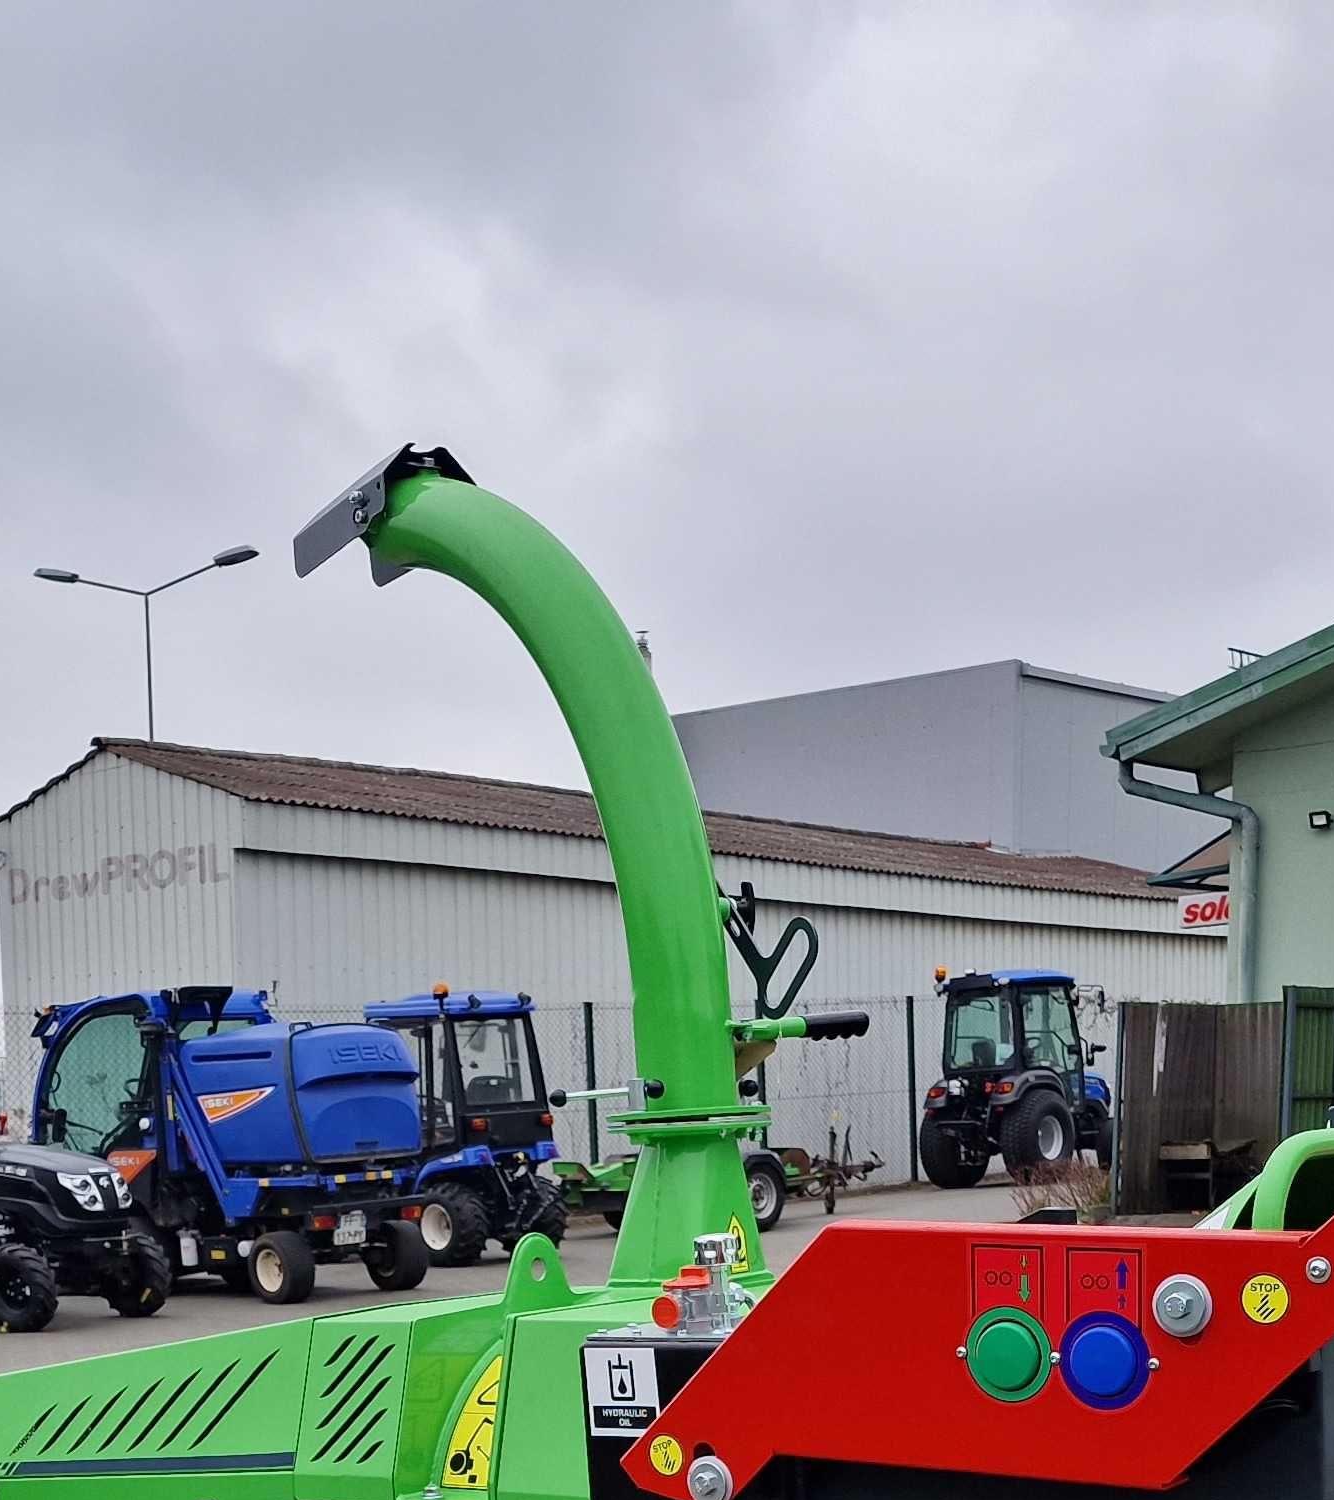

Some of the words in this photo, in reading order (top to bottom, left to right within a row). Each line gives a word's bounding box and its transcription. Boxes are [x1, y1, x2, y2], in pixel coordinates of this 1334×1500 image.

[10, 843, 230, 905] DrewPROFIL
[327, 1044, 403, 1065] ISEKI
[1250, 1282, 1280, 1293] STOP
[602, 1408, 648, 1418] HYDRAULIC
[618, 1418, 633, 1427] OIL
[652, 1439, 673, 1453] STOP
